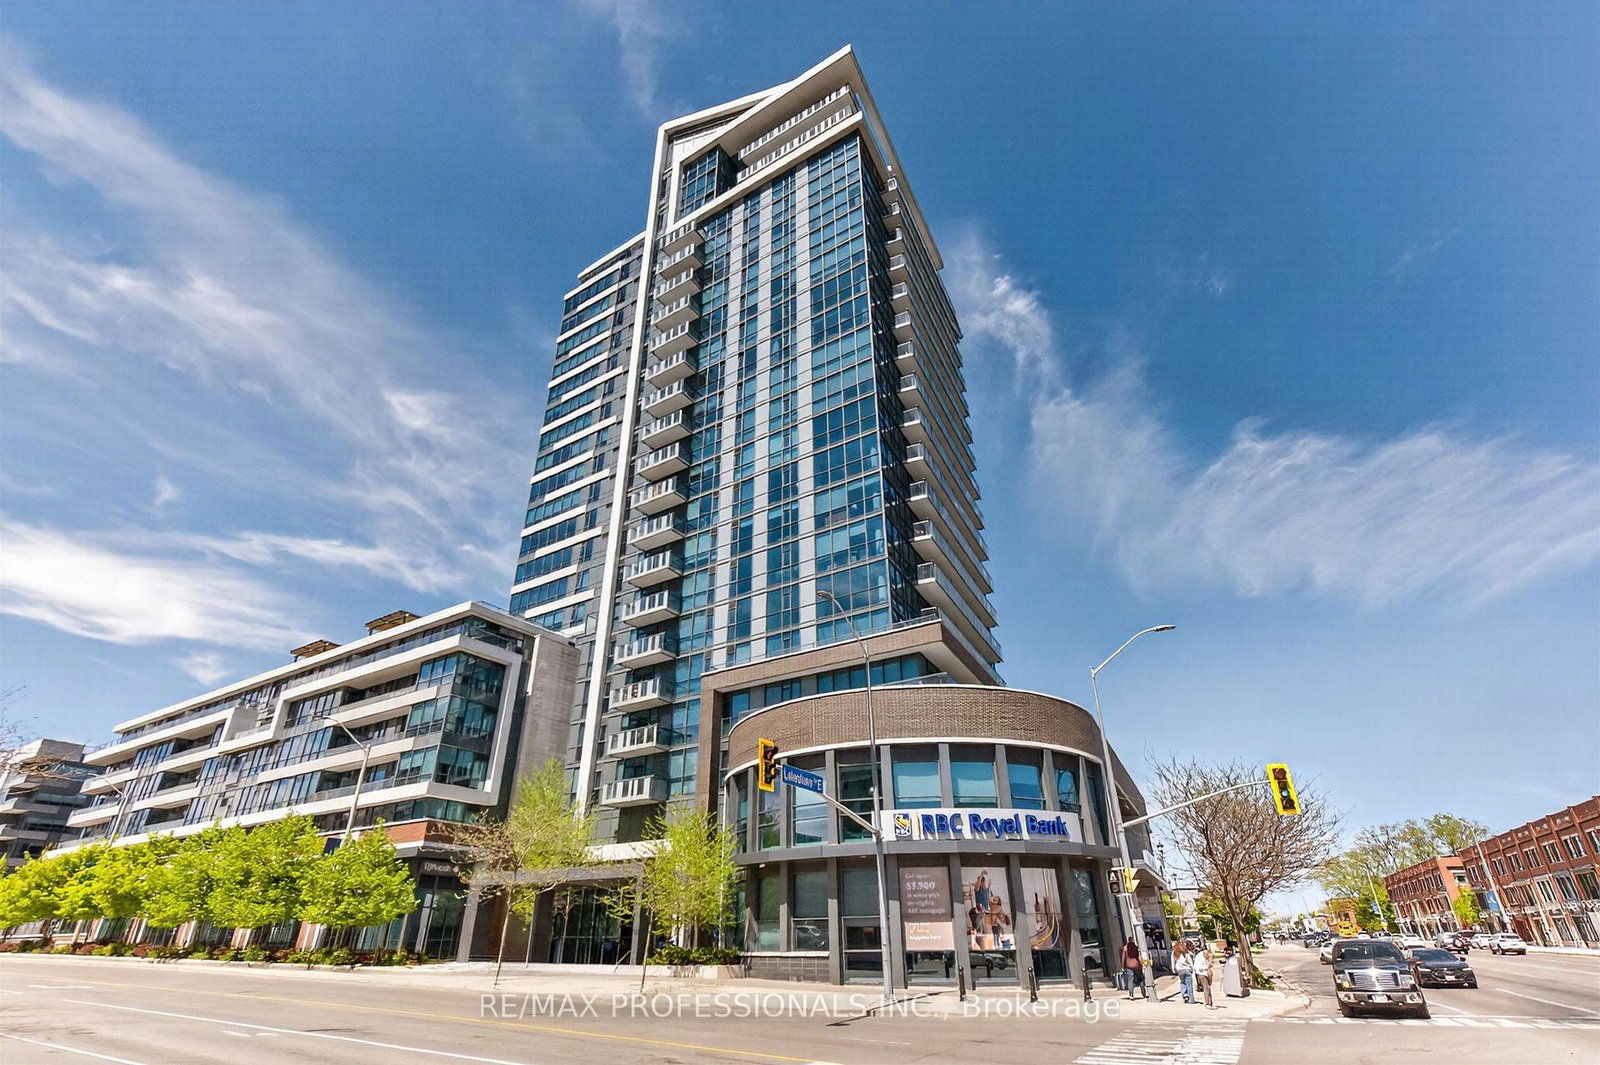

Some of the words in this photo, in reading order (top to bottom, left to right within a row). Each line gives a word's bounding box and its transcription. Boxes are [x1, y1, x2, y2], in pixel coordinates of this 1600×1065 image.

[817, 779, 822, 791] E
[921, 813, 963, 834] RBC
[968, 813, 1022, 838] Royal
[1025, 814, 1069, 836] Bank
